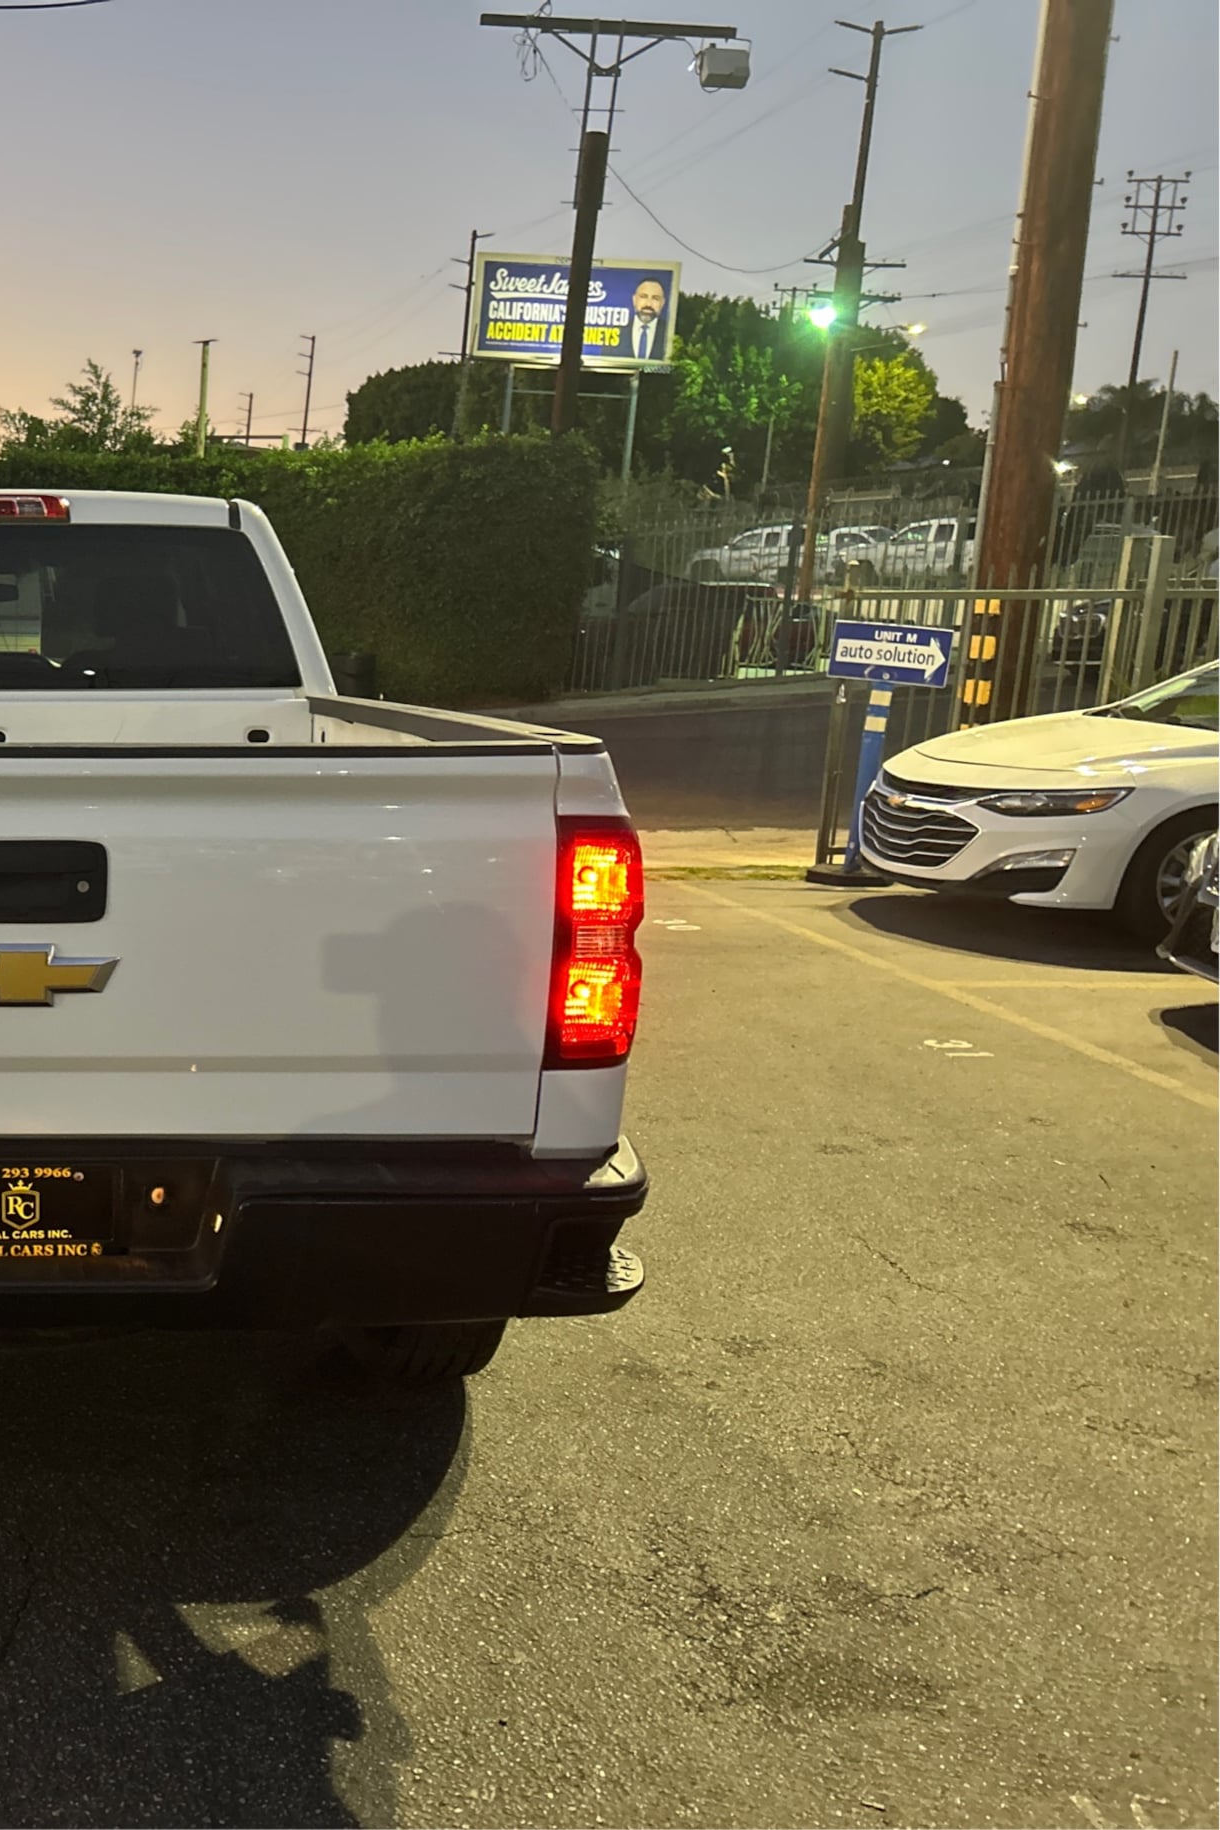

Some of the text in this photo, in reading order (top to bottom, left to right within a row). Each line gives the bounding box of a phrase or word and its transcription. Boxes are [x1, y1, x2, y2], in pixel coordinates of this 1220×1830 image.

[489, 268, 603, 298] Sweet Jaes
[584, 306, 630, 326] USTED
[486, 321, 548, 342] ACCIDENT
[548, 327, 621, 346] ATNEYS
[874, 630, 918, 644] UNIT M
[840, 645, 935, 666] auto solution
[2, 1168, 30, 1179] 293
[34, 1167, 71, 1179] 9966
[7, 1195, 35, 1220] RC
[12, 1230, 45, 1240] CARS
[47, 1229, 73, 1239] INC.
[10, 1244, 54, 1257] CARS
[57, 1243, 88, 1256] INC
